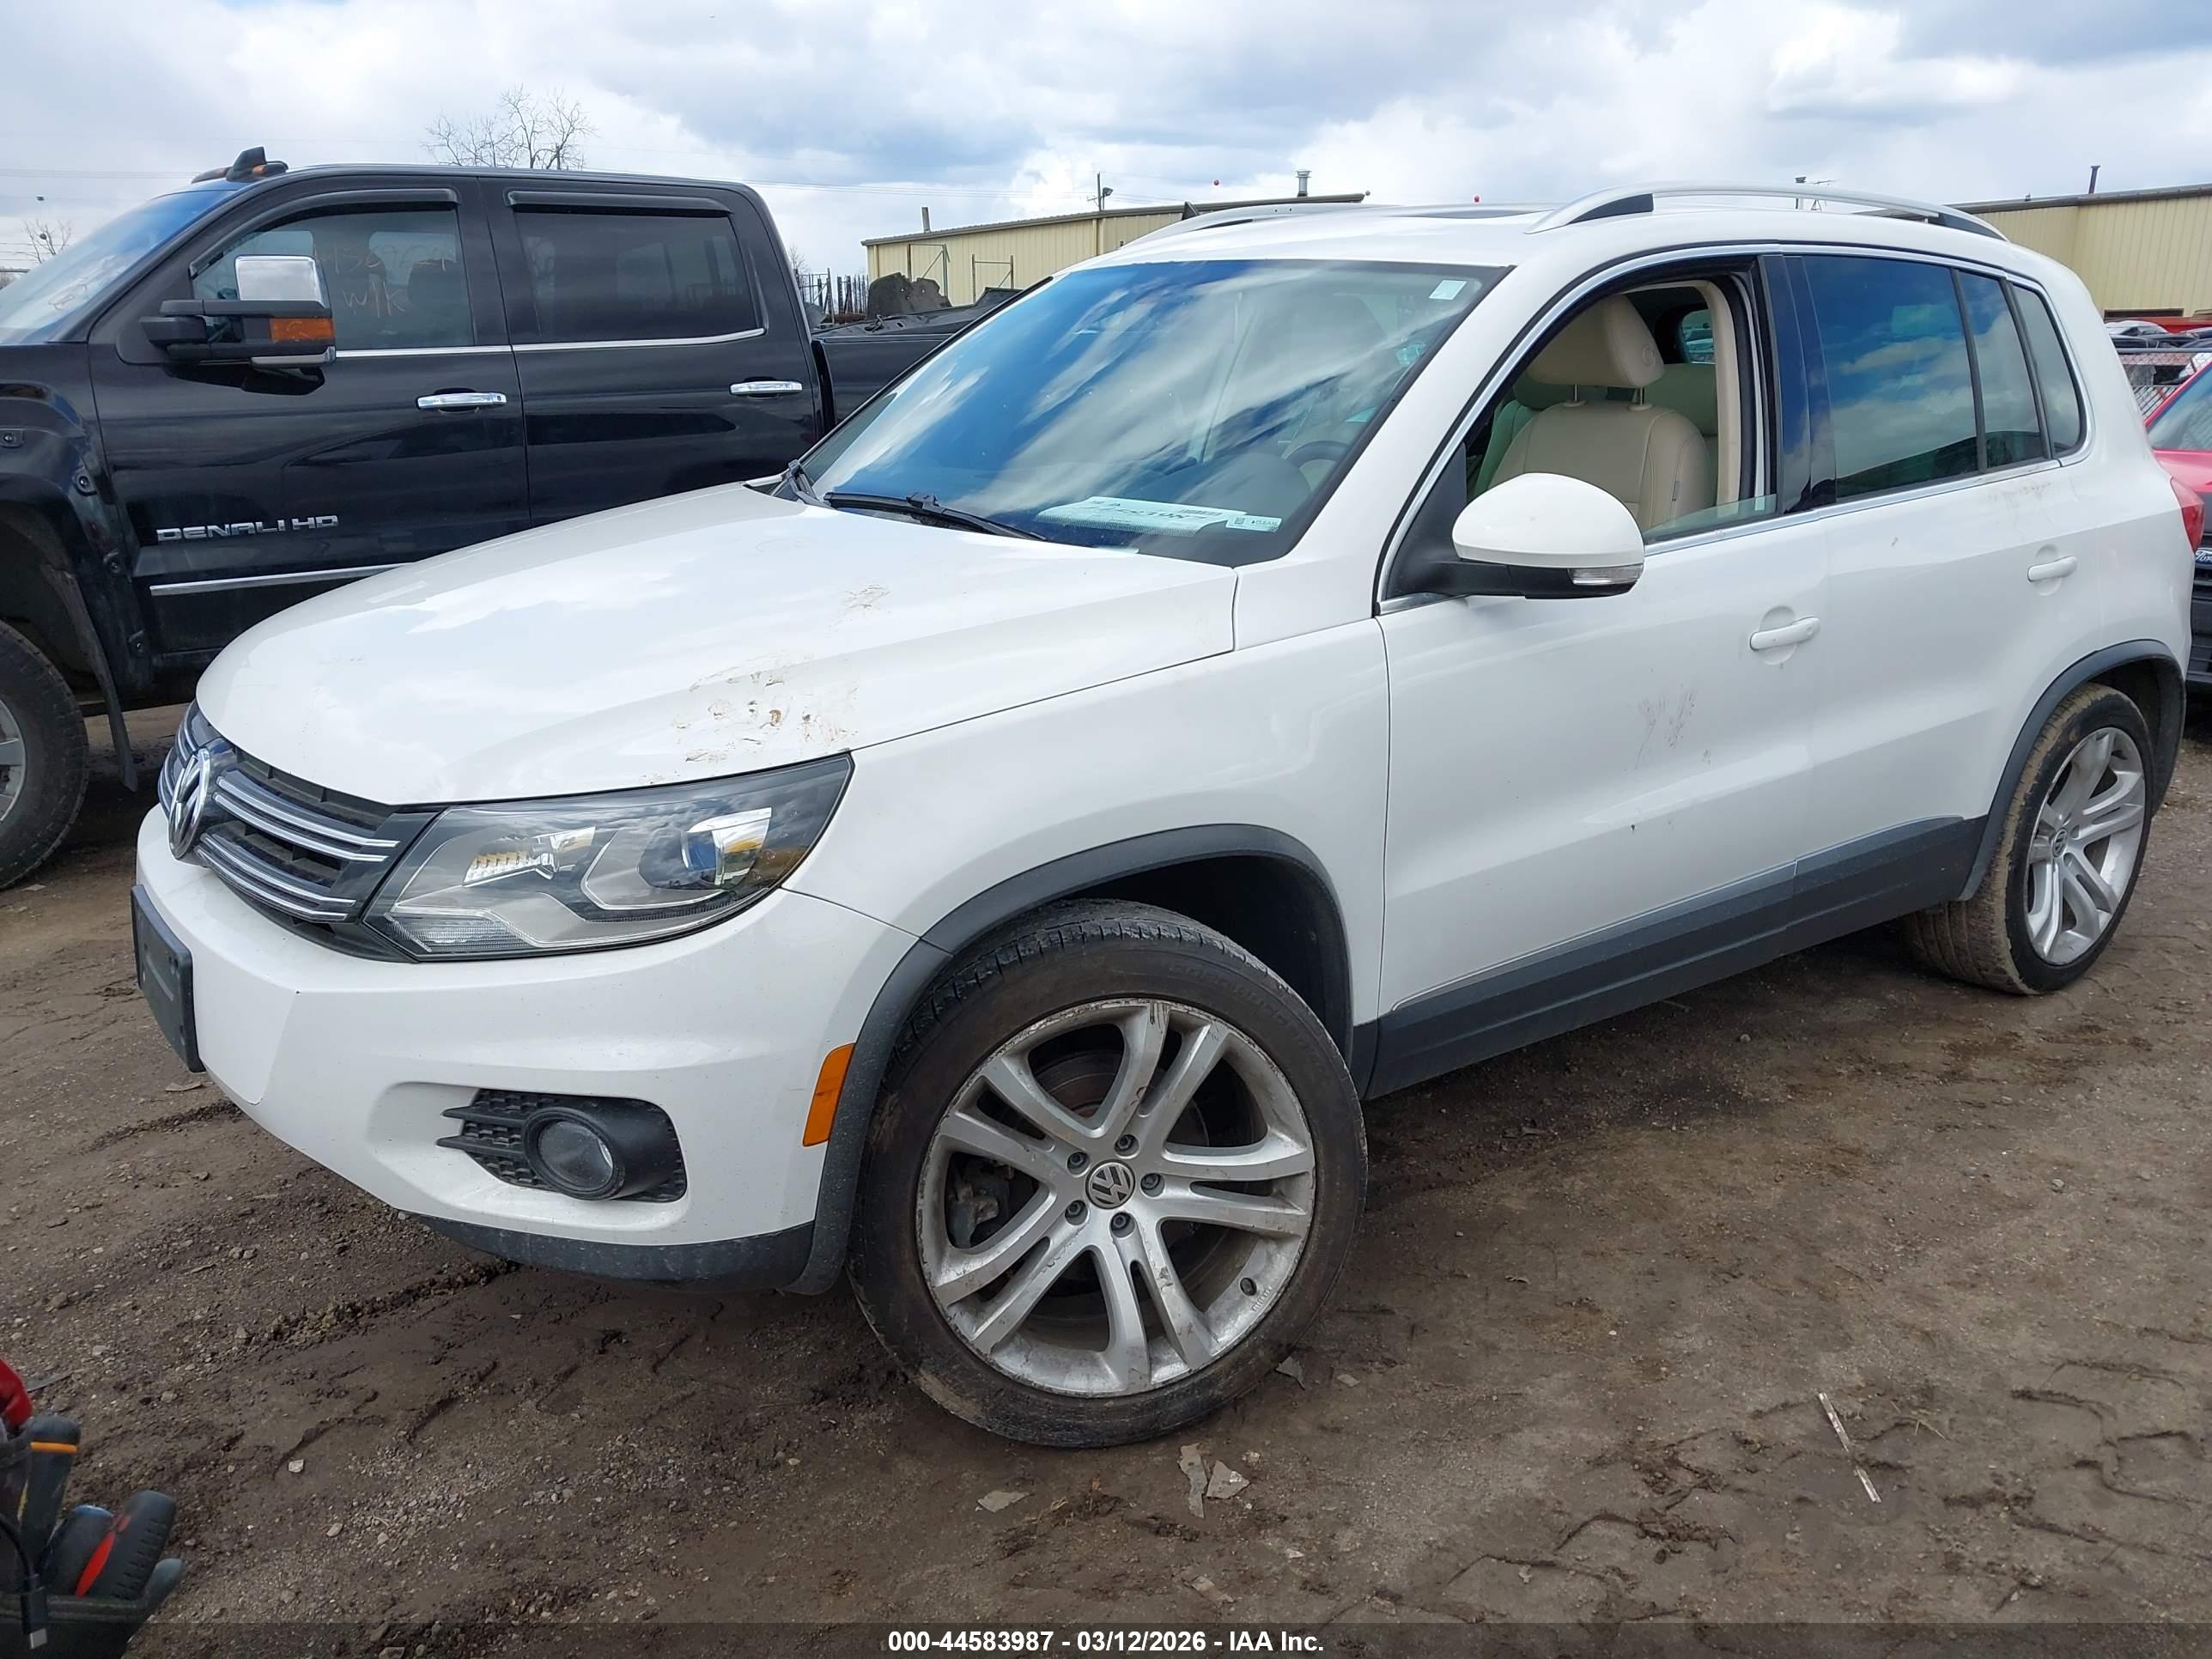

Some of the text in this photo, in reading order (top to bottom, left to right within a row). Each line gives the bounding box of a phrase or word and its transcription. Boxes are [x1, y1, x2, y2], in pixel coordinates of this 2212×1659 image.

[156, 515, 339, 542] DENALI HD
[1086, 1160, 1135, 1209] VW
